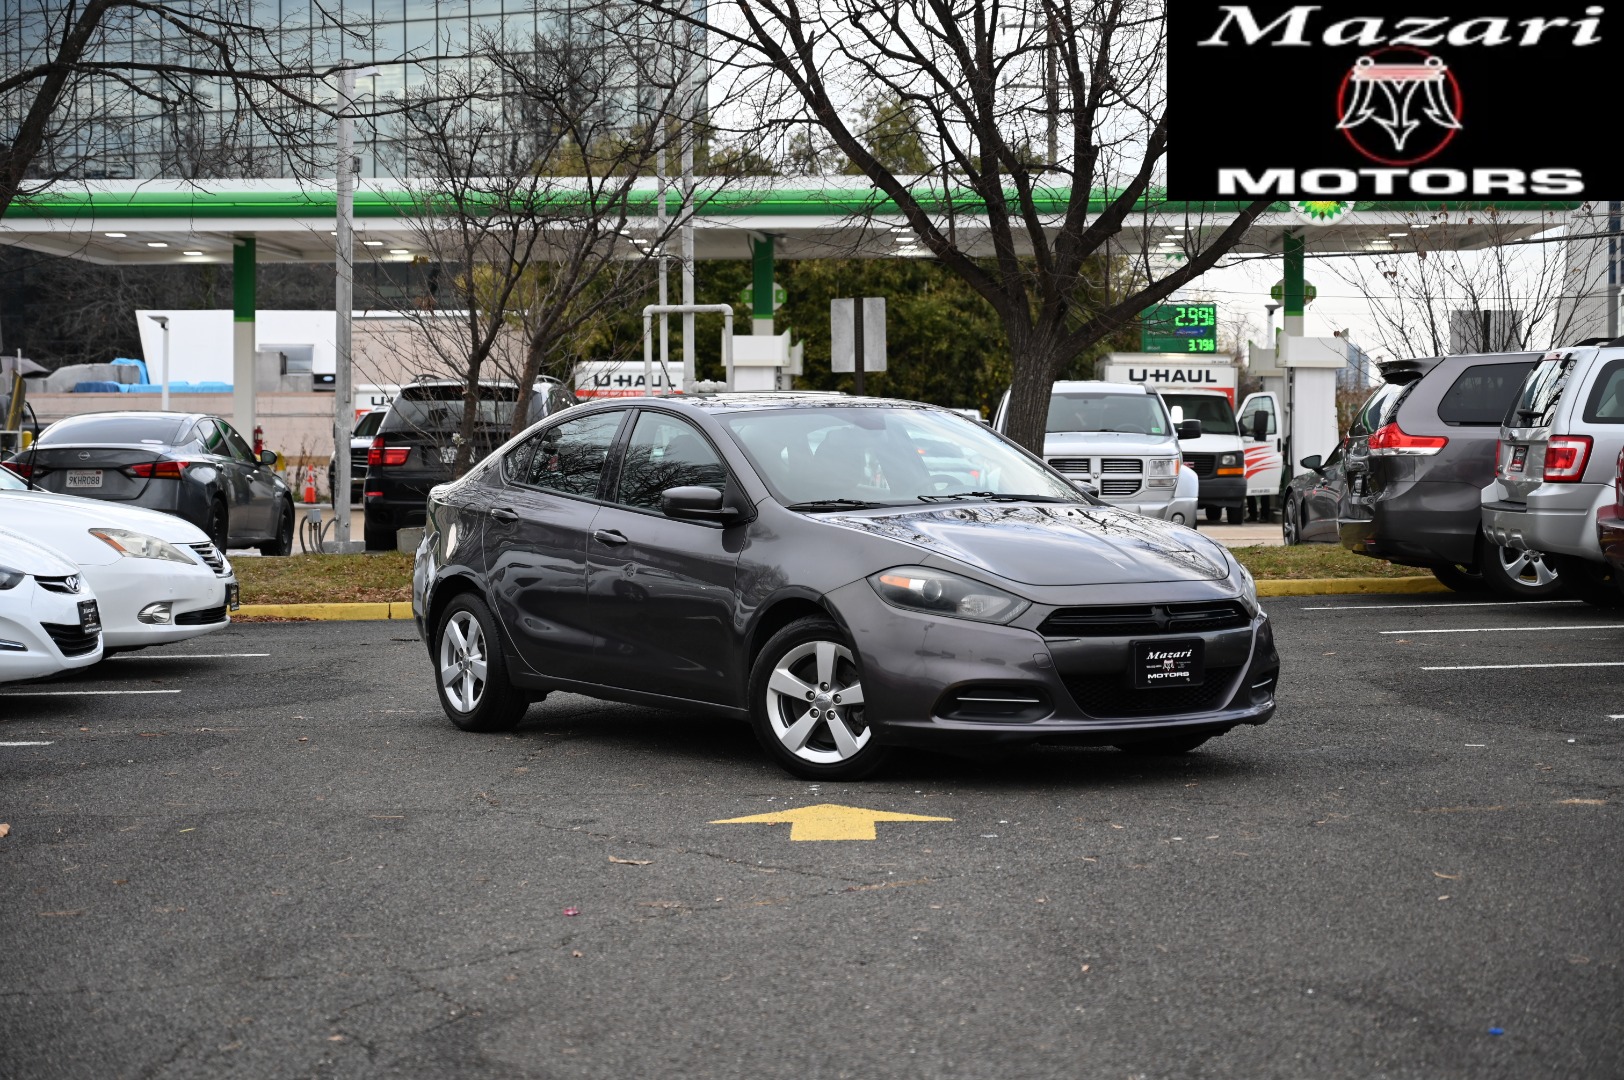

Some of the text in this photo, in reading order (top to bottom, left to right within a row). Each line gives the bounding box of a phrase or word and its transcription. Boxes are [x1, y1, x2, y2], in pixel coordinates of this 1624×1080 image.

[778, 291, 784, 301] 4
[1129, 368, 1217, 383] U-HAUL
[1146, 649, 1193, 660] Mazari
[1147, 671, 1190, 679] MOTORS
